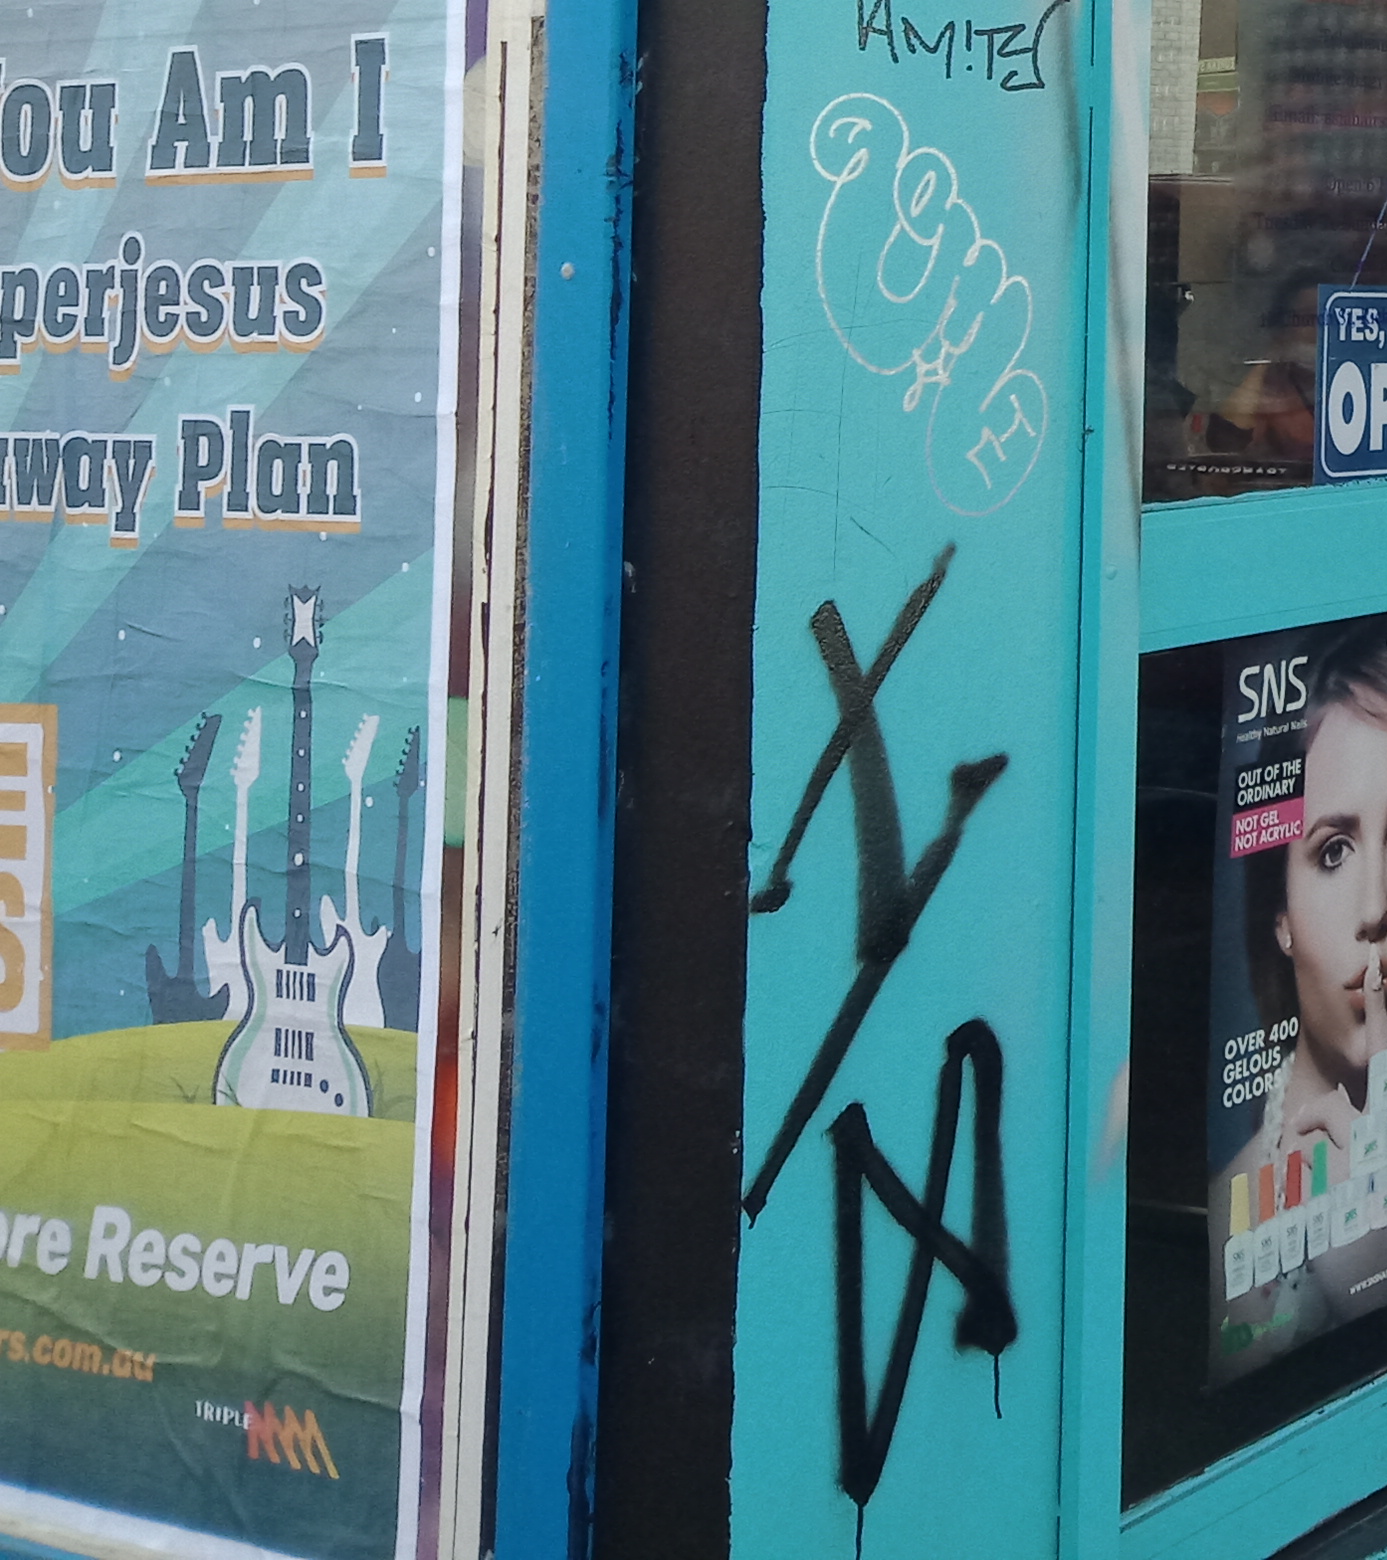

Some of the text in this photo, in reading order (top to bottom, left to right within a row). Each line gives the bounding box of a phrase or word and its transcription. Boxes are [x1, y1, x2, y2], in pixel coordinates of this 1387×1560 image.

[0, 33, 389, 188] ou Am I
[0, 232, 327, 378] perjesus
[1334, 307, 1386, 350] YES,
[0, 404, 361, 547] way Plan
[1238, 656, 1309, 724] SNS
[1264, 722, 1290, 737] Natural
[1237, 777, 1296, 806] ORDINARY
[1238, 759, 1302, 788] OUT OF THE
[1234, 820, 1301, 852] NOT ACRYLIC
[1236, 810, 1279, 835] NOT GEL
[1224, 1016, 1299, 1060] OVER 400
[1223, 1046, 1281, 1084] GELOUS
[0, 1205, 350, 1311] re Reserve
[195, 1399, 253, 1431] TRIPLE
